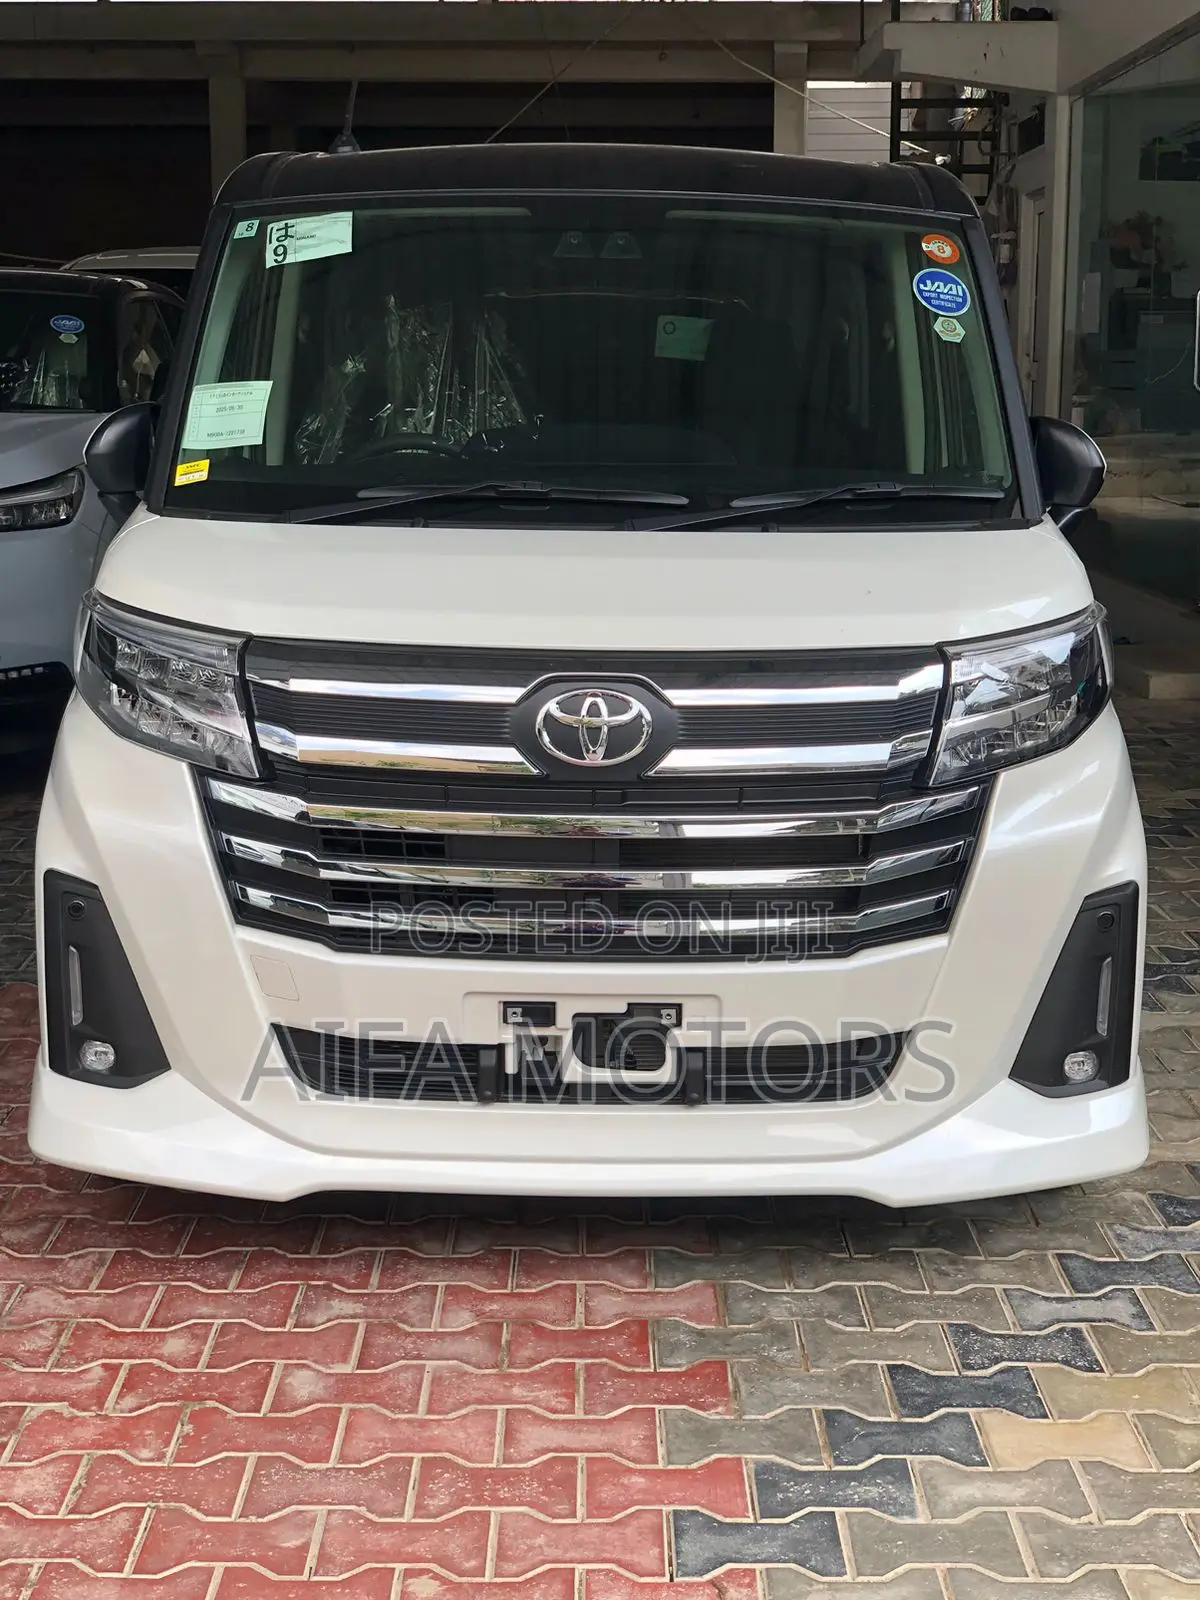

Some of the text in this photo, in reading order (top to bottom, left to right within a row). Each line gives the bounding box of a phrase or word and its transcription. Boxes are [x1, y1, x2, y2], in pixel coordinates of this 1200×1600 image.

[245, 222, 255, 232] 8
[269, 222, 296, 244] は
[272, 244, 289, 264] 9
[919, 280, 963, 296] JAAI
[922, 291, 963, 303] EXPORT INSPECTION
[931, 299, 956, 308] CERTIFICATE
